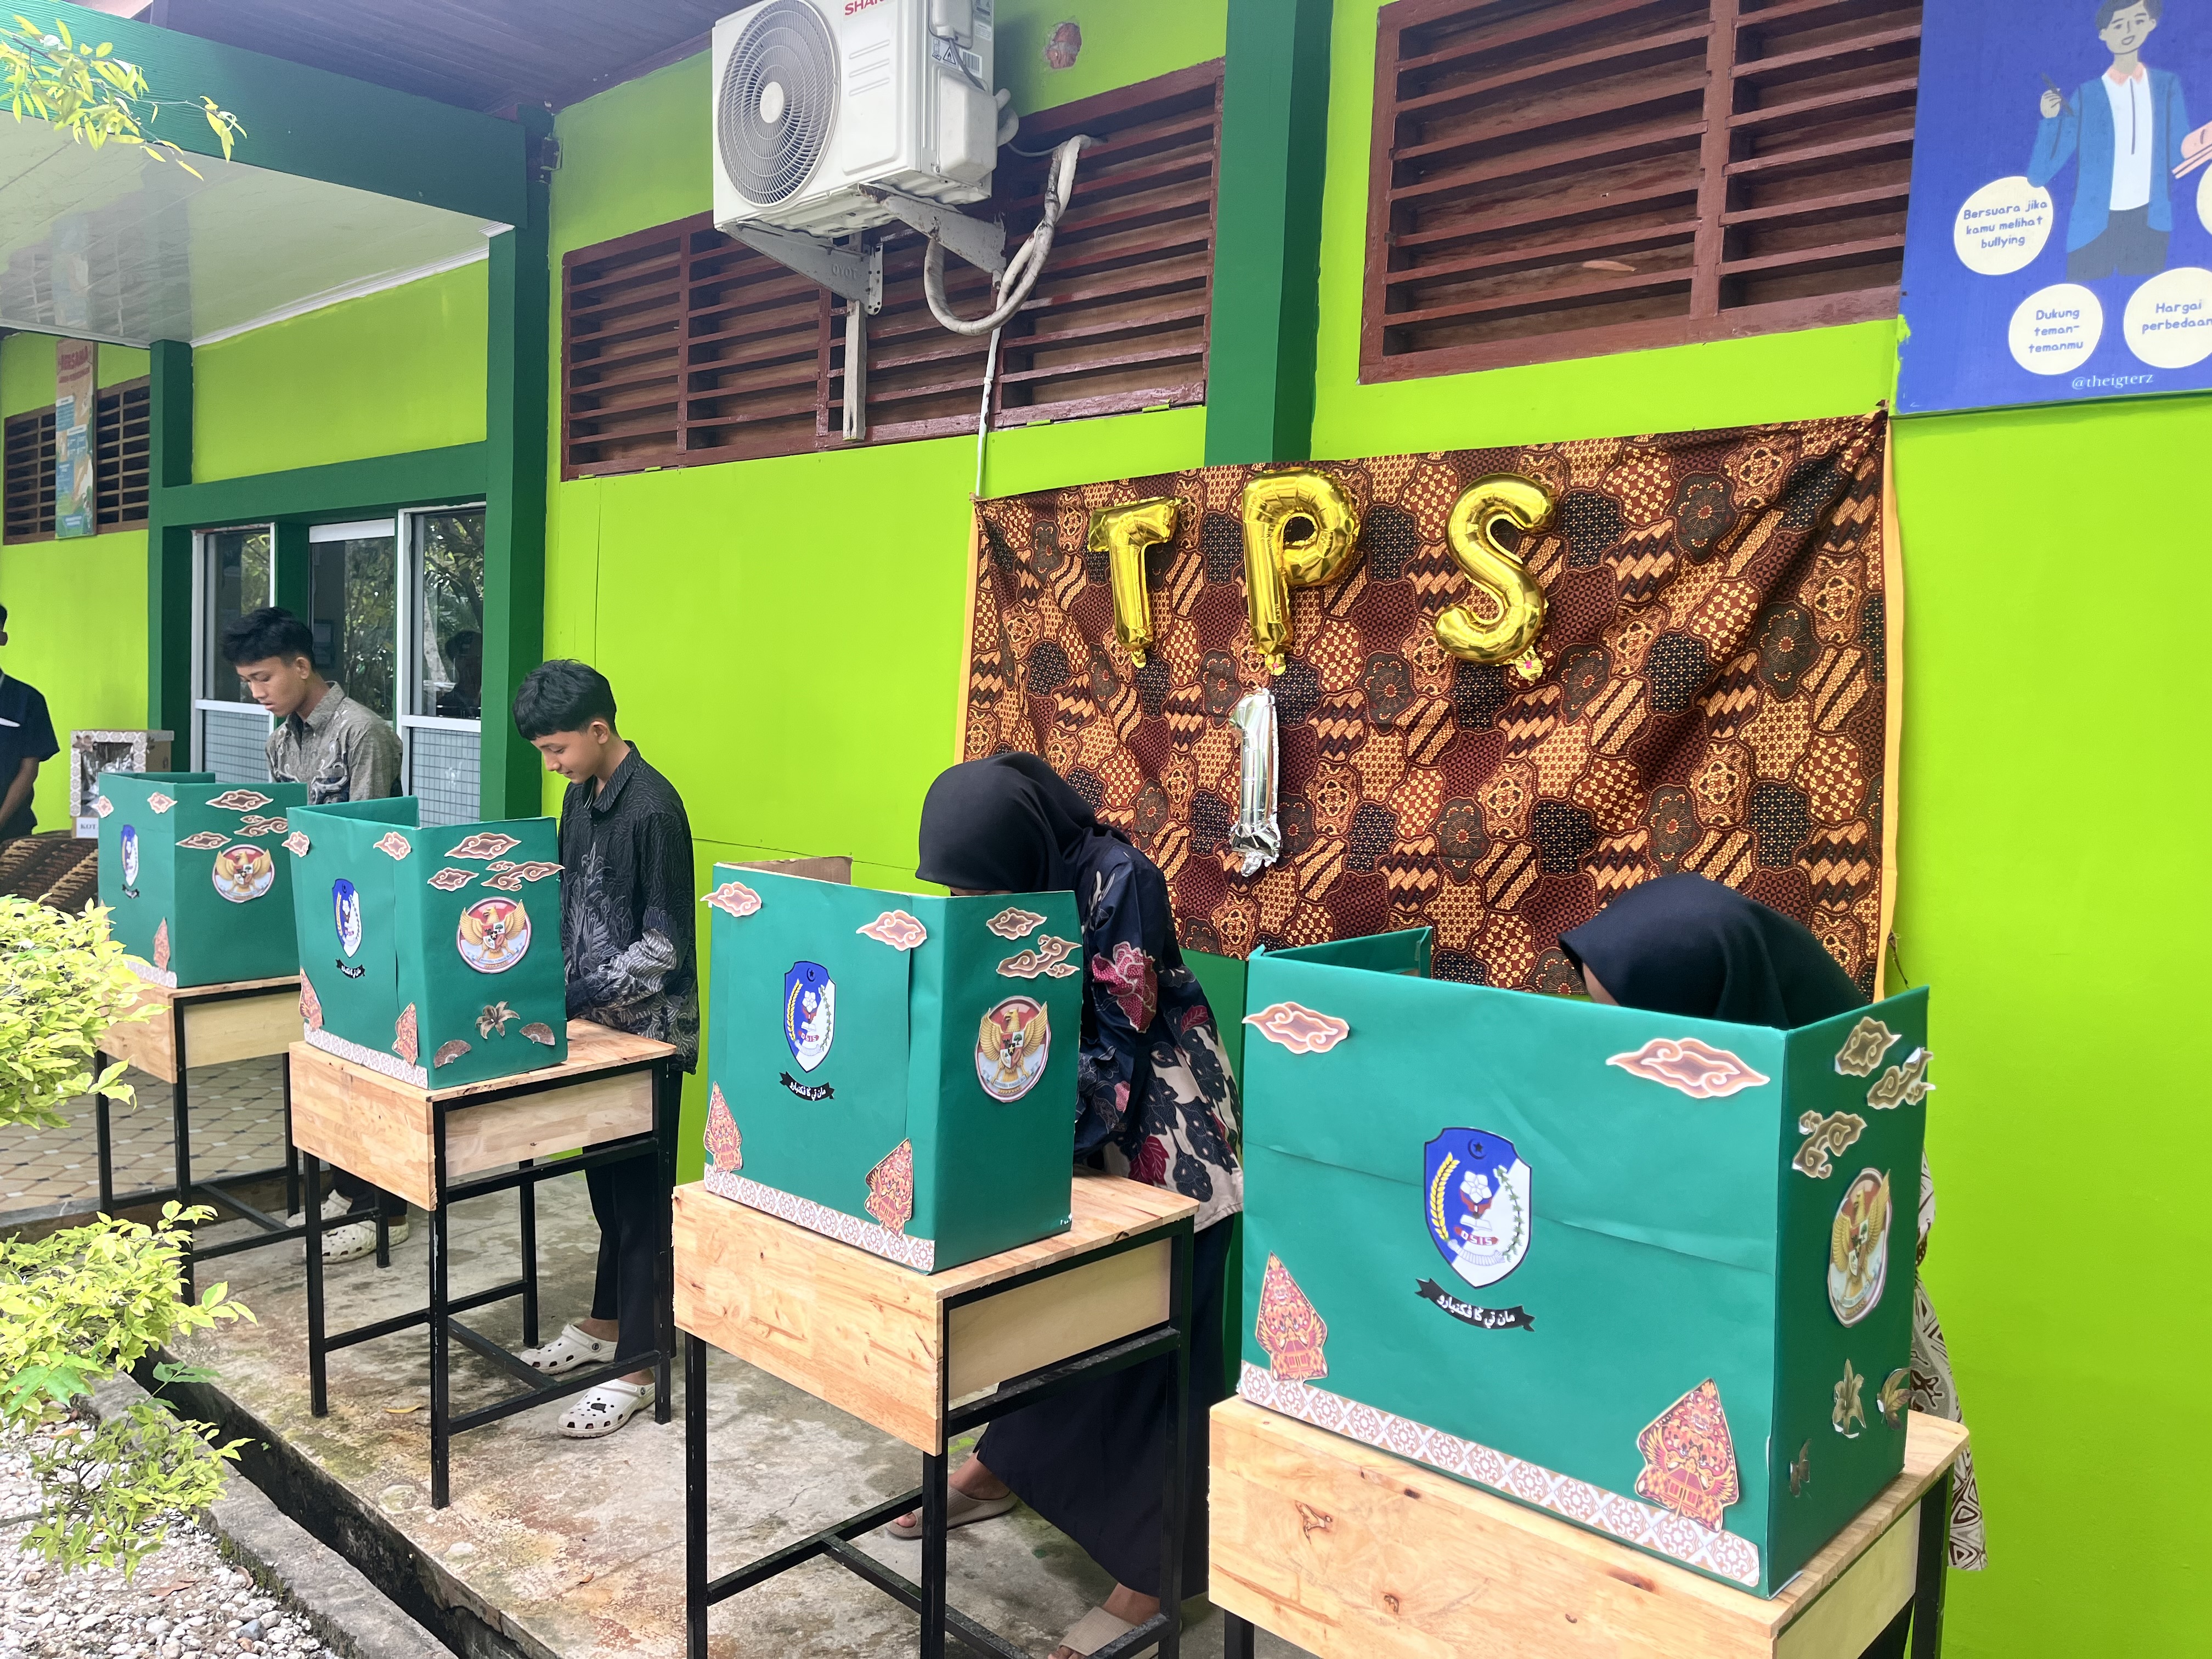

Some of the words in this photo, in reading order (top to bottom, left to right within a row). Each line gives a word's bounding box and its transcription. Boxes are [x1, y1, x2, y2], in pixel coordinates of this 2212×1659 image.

[845, 0, 884, 15] SHA
[1963, 205, 2021, 219] Bersuara
[2025, 200, 2047, 212] jika
[1966, 224, 1995, 235] kamu
[1999, 216, 2043, 230] melihat
[1981, 235, 2025, 249] bullying
[2036, 308, 2080, 320] Dukung
[2155, 299, 2202, 314] Hargai
[2034, 325, 2080, 336] teman-
[2028, 341, 2084, 353] temanmu
[1460, 1230, 1493, 1246] OSIS
